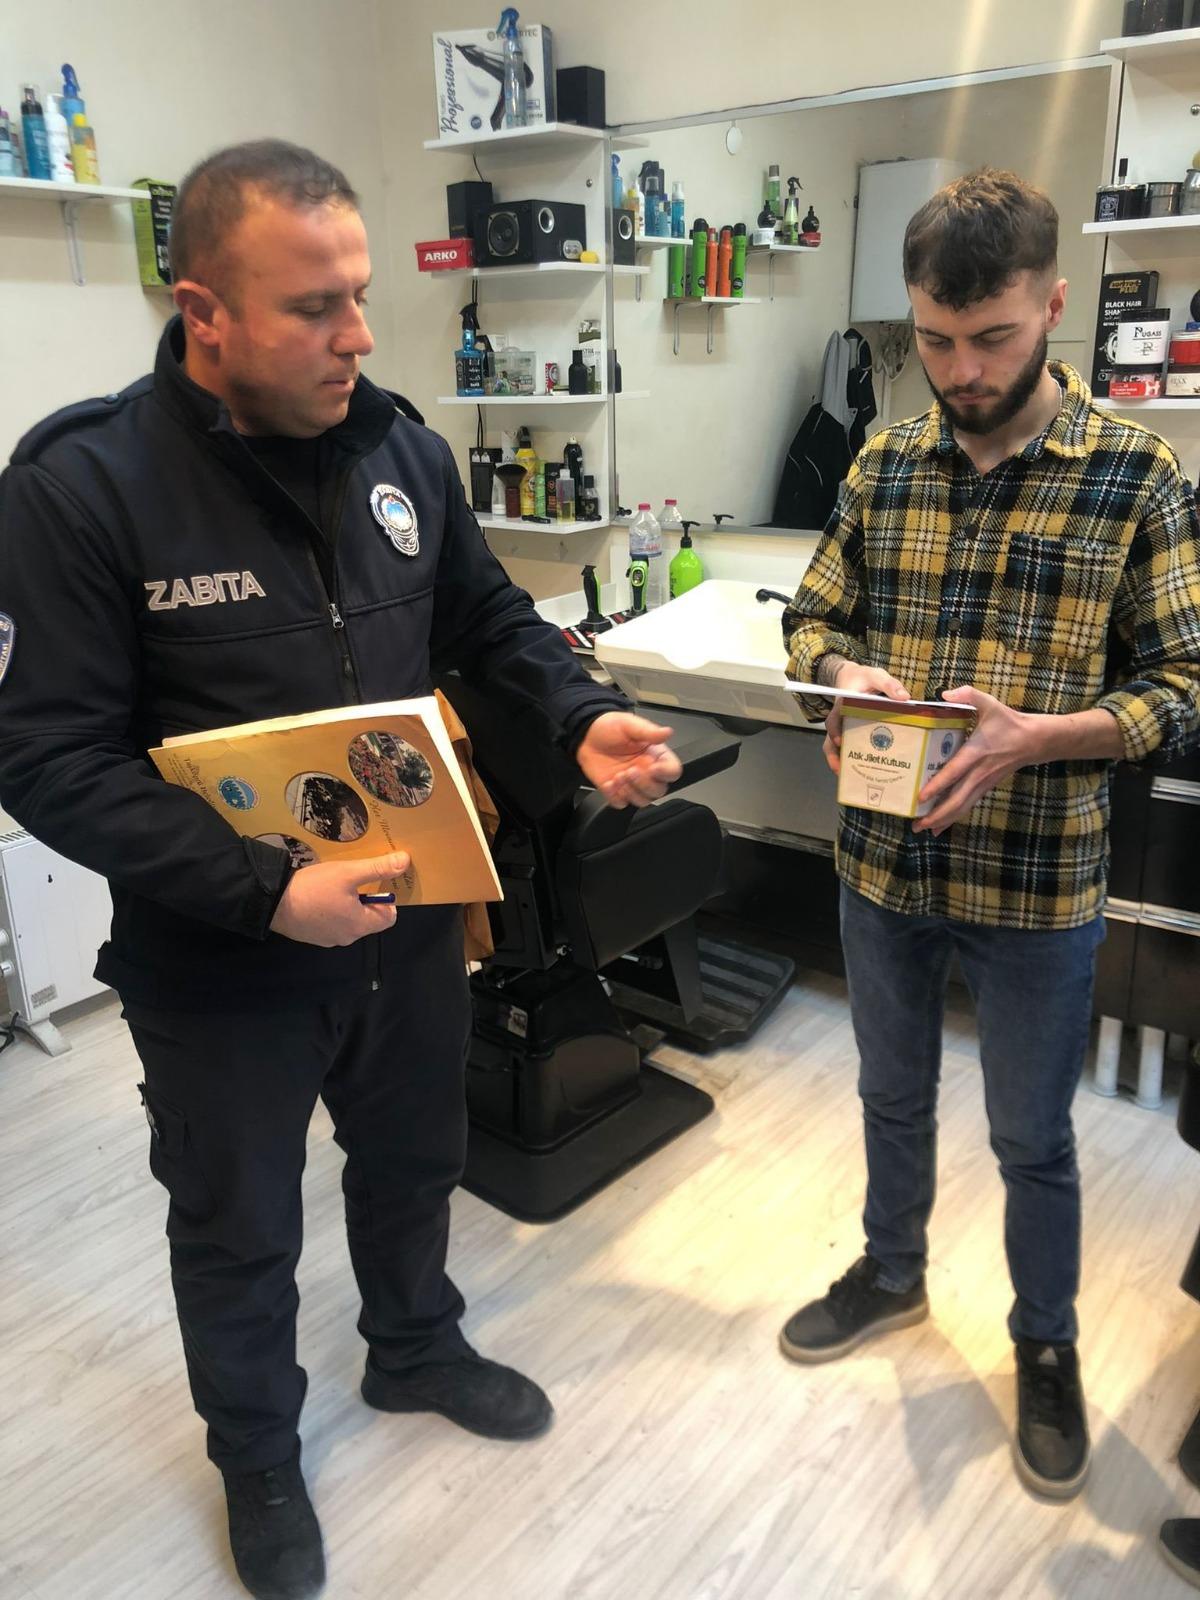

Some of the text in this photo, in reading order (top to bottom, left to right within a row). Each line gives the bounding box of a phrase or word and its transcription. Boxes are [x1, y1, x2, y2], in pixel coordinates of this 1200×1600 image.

[497, 29, 538, 39] PORTEC
[437, 38, 464, 133] Professional
[424, 250, 458, 262] ARKO
[144, 570, 266, 611] ZABITA
[864, 753, 881, 765] Jilet
[881, 756, 911, 769] Kutusu
